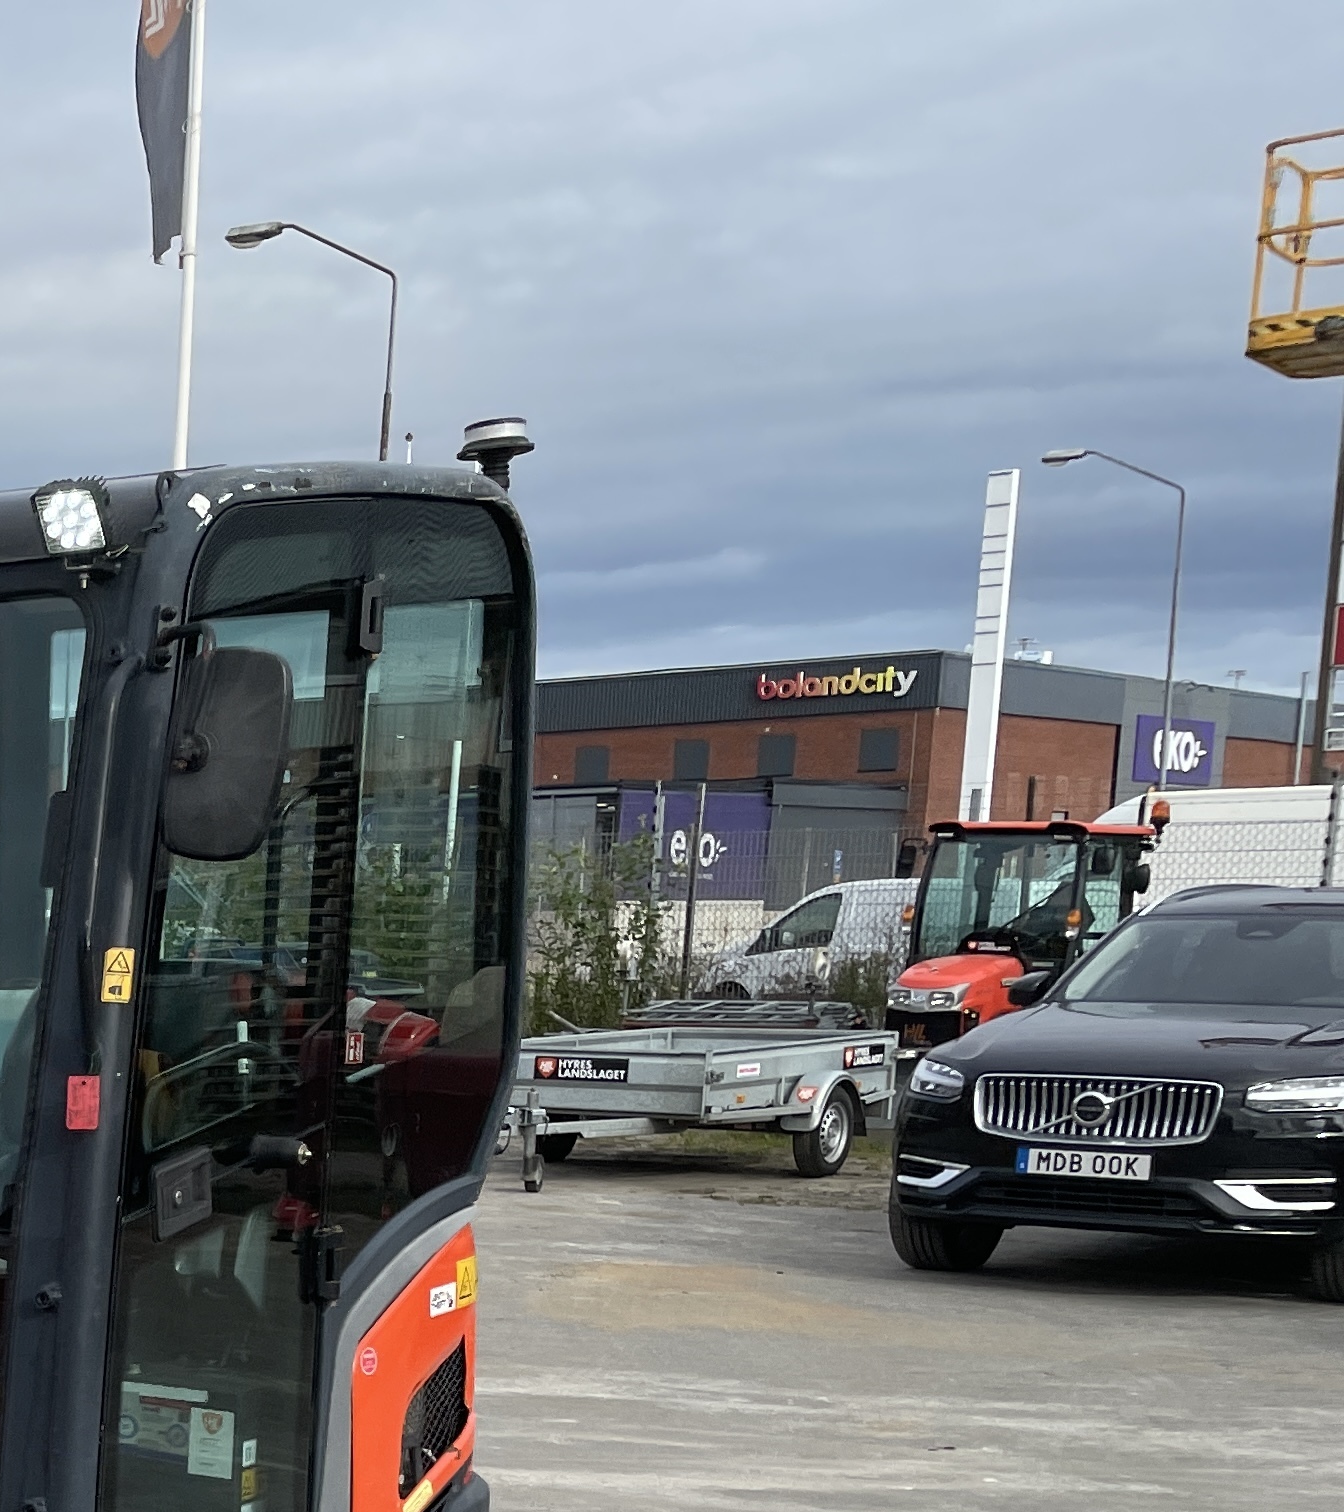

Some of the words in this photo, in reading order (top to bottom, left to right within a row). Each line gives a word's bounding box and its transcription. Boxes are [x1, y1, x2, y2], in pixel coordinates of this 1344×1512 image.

[558, 1058, 593, 1070] HYRES
[558, 1068, 626, 1081] LANDSLAGET
[1036, 1151, 1083, 1173] MDB
